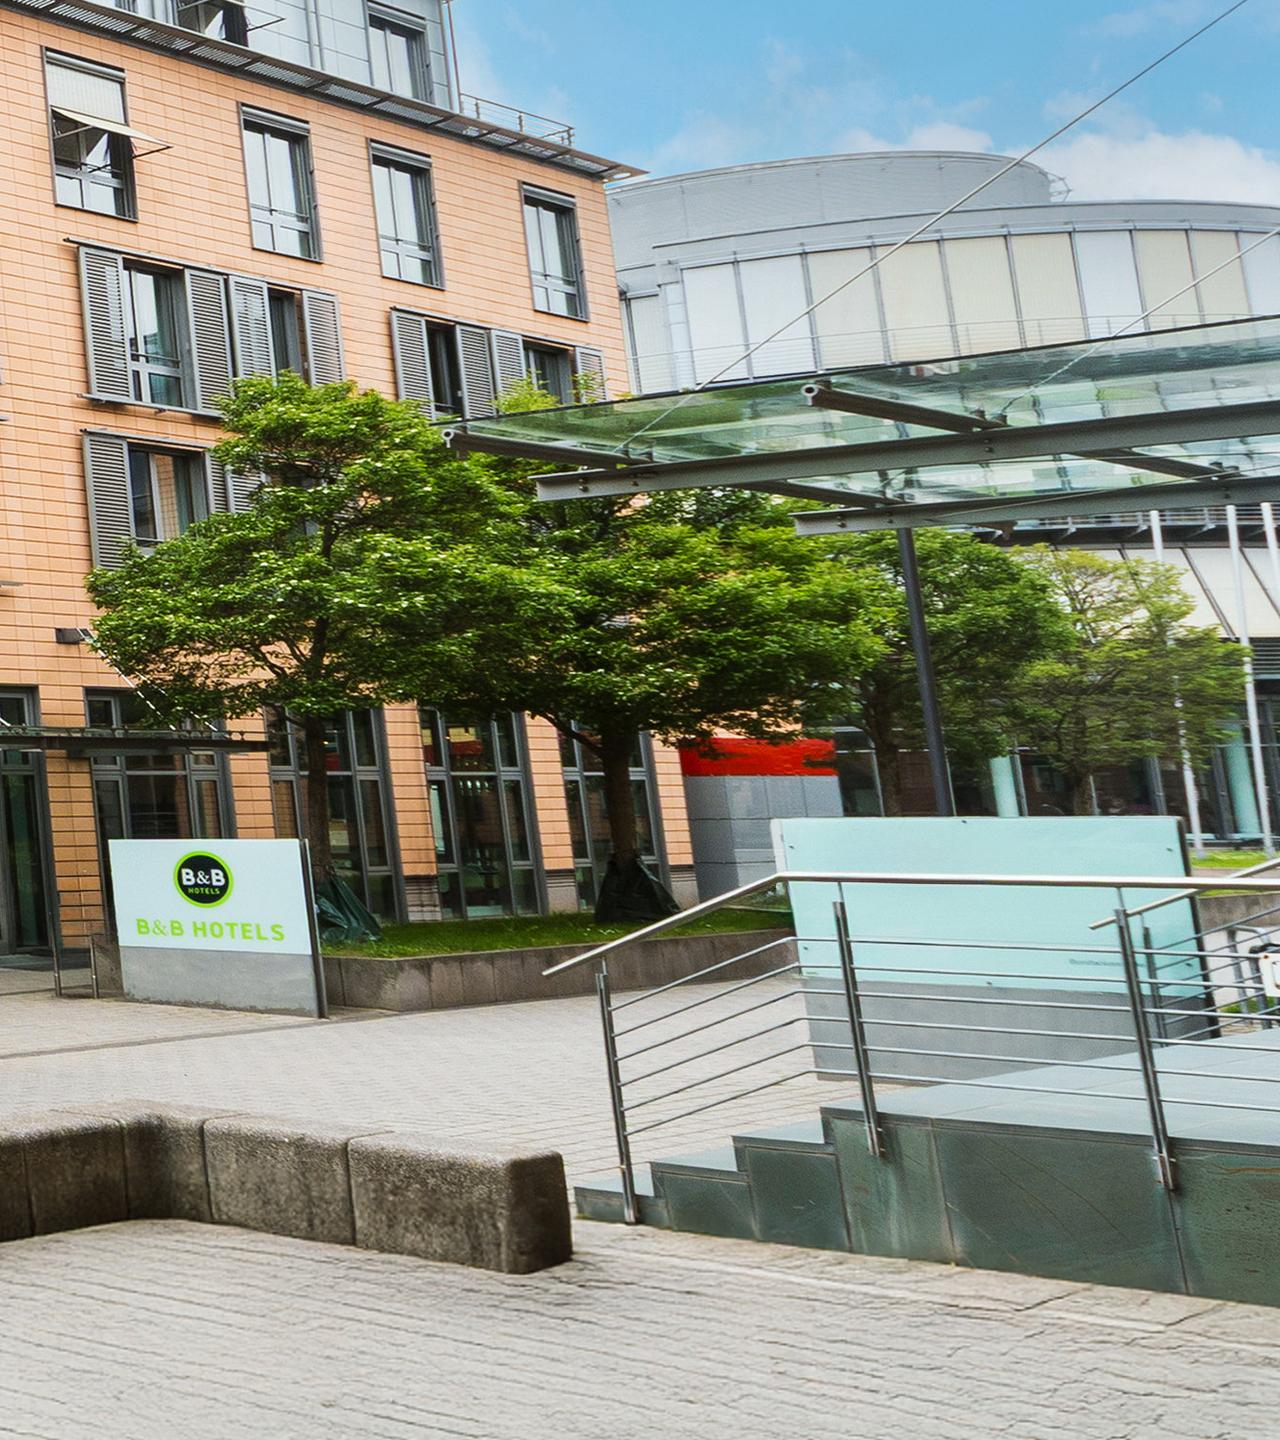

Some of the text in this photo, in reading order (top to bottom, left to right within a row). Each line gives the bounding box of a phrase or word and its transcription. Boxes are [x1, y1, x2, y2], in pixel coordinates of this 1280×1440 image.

[181, 868, 225, 886] B&B
[136, 918, 285, 941] B&B HOTELS
